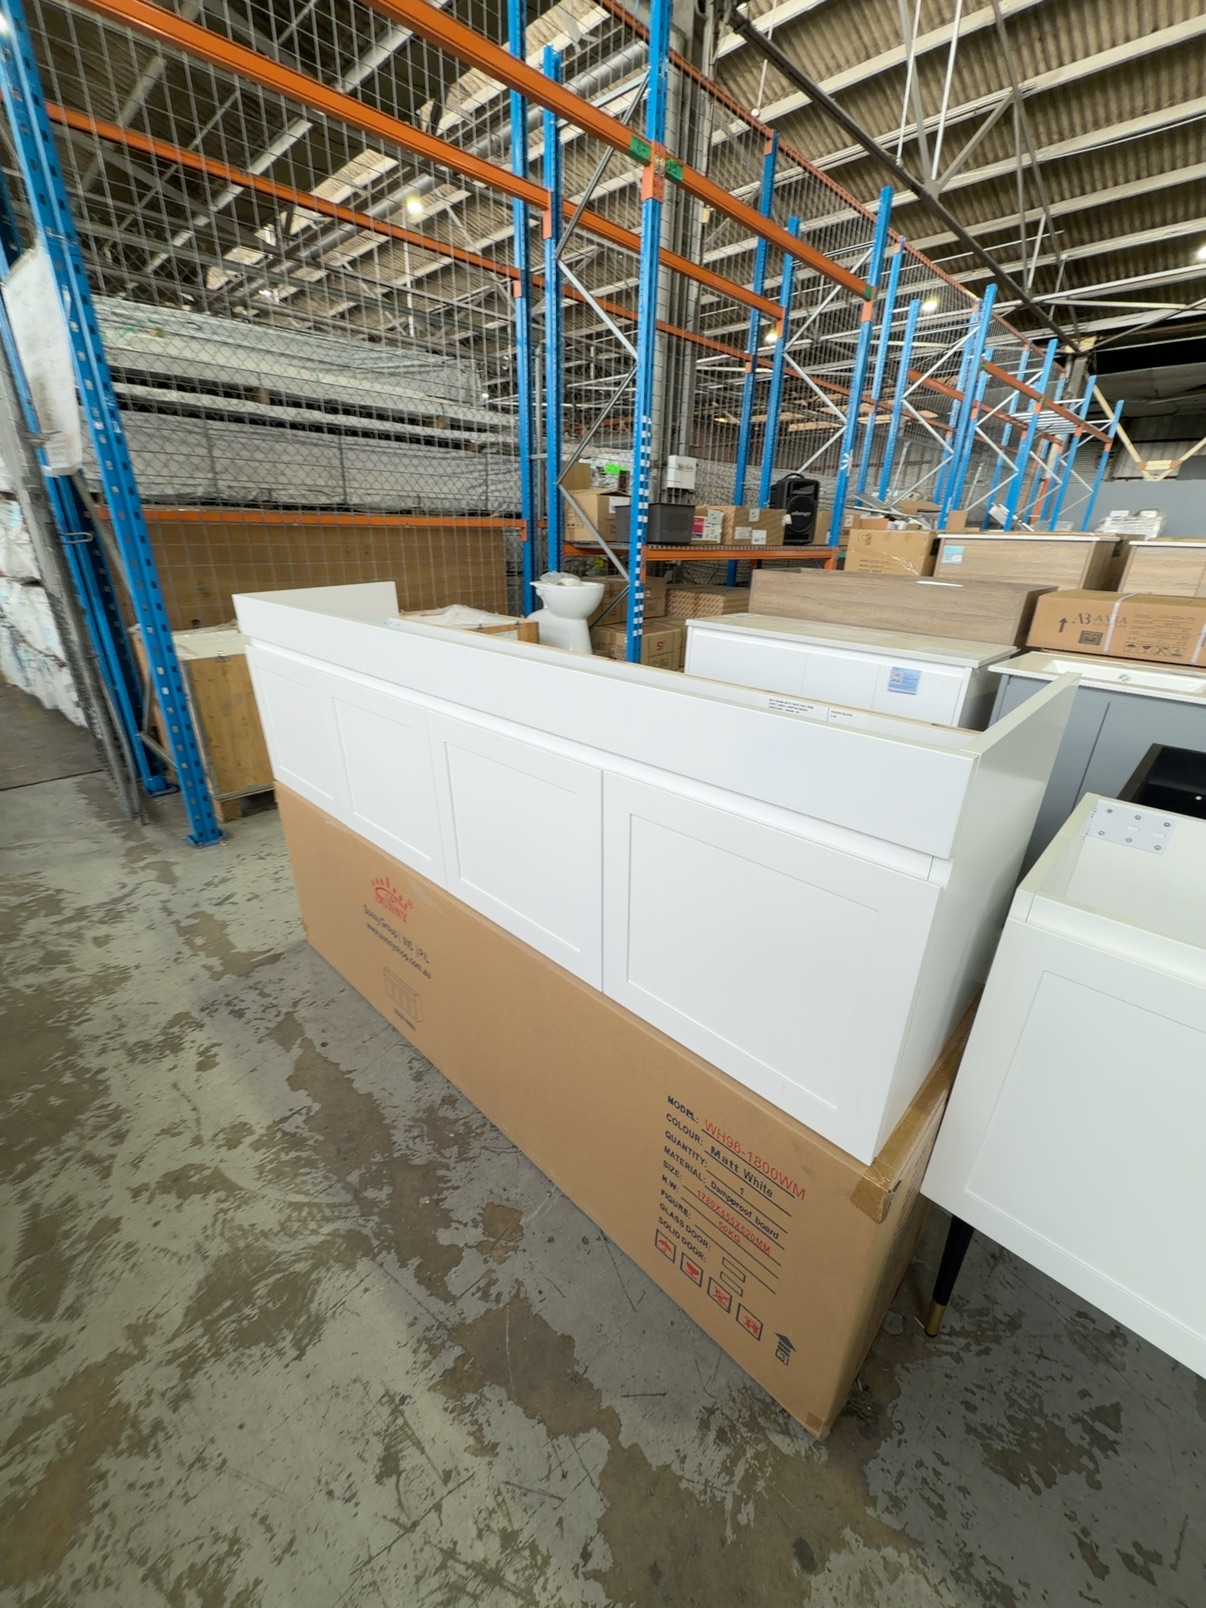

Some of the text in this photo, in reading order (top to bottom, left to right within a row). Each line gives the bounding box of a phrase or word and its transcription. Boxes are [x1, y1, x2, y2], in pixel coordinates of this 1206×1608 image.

[662, 1160, 683, 1180] SIZE:
[665, 1130, 745, 1196] QUANTITY: 1
[666, 1113, 774, 1198] COLOUR: Matt White
[667, 1095, 806, 1200] MODEL: WH96-1800WM
[660, 1188, 692, 1220] FIGURE:
[663, 1145, 780, 1240] MATERIAL: Dampproof board
[658, 1216, 707, 1263] SOLID DOOR:
[659, 1202, 712, 1251] GLASS DOOR:
